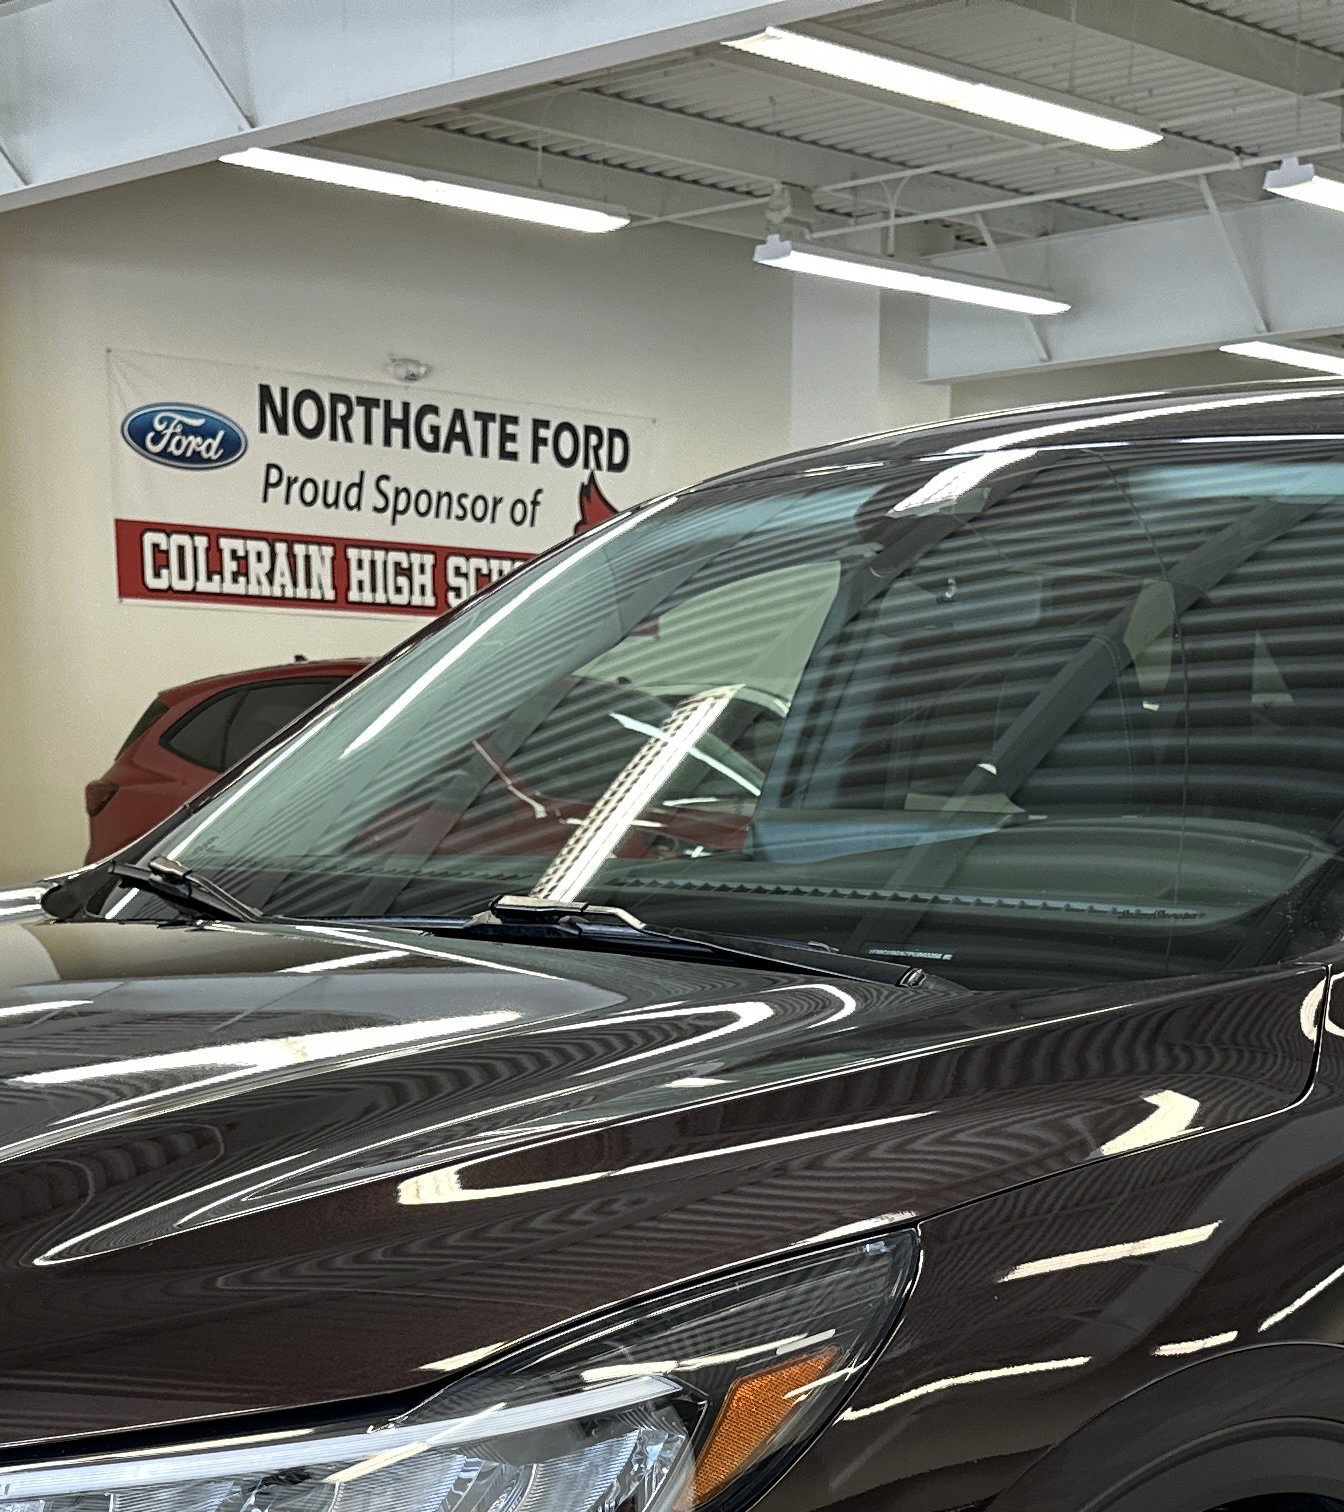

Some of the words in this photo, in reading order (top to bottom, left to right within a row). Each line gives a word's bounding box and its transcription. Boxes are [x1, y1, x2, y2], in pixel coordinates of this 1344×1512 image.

[145, 406, 224, 462] Ford
[257, 383, 519, 463] NORTHGATE
[531, 418, 630, 474] FORD
[262, 463, 365, 512] Proud
[374, 474, 504, 527] Sponsor
[509, 488, 544, 528] of
[141, 530, 336, 602] COLERAIN
[348, 549, 436, 608] HIGH
